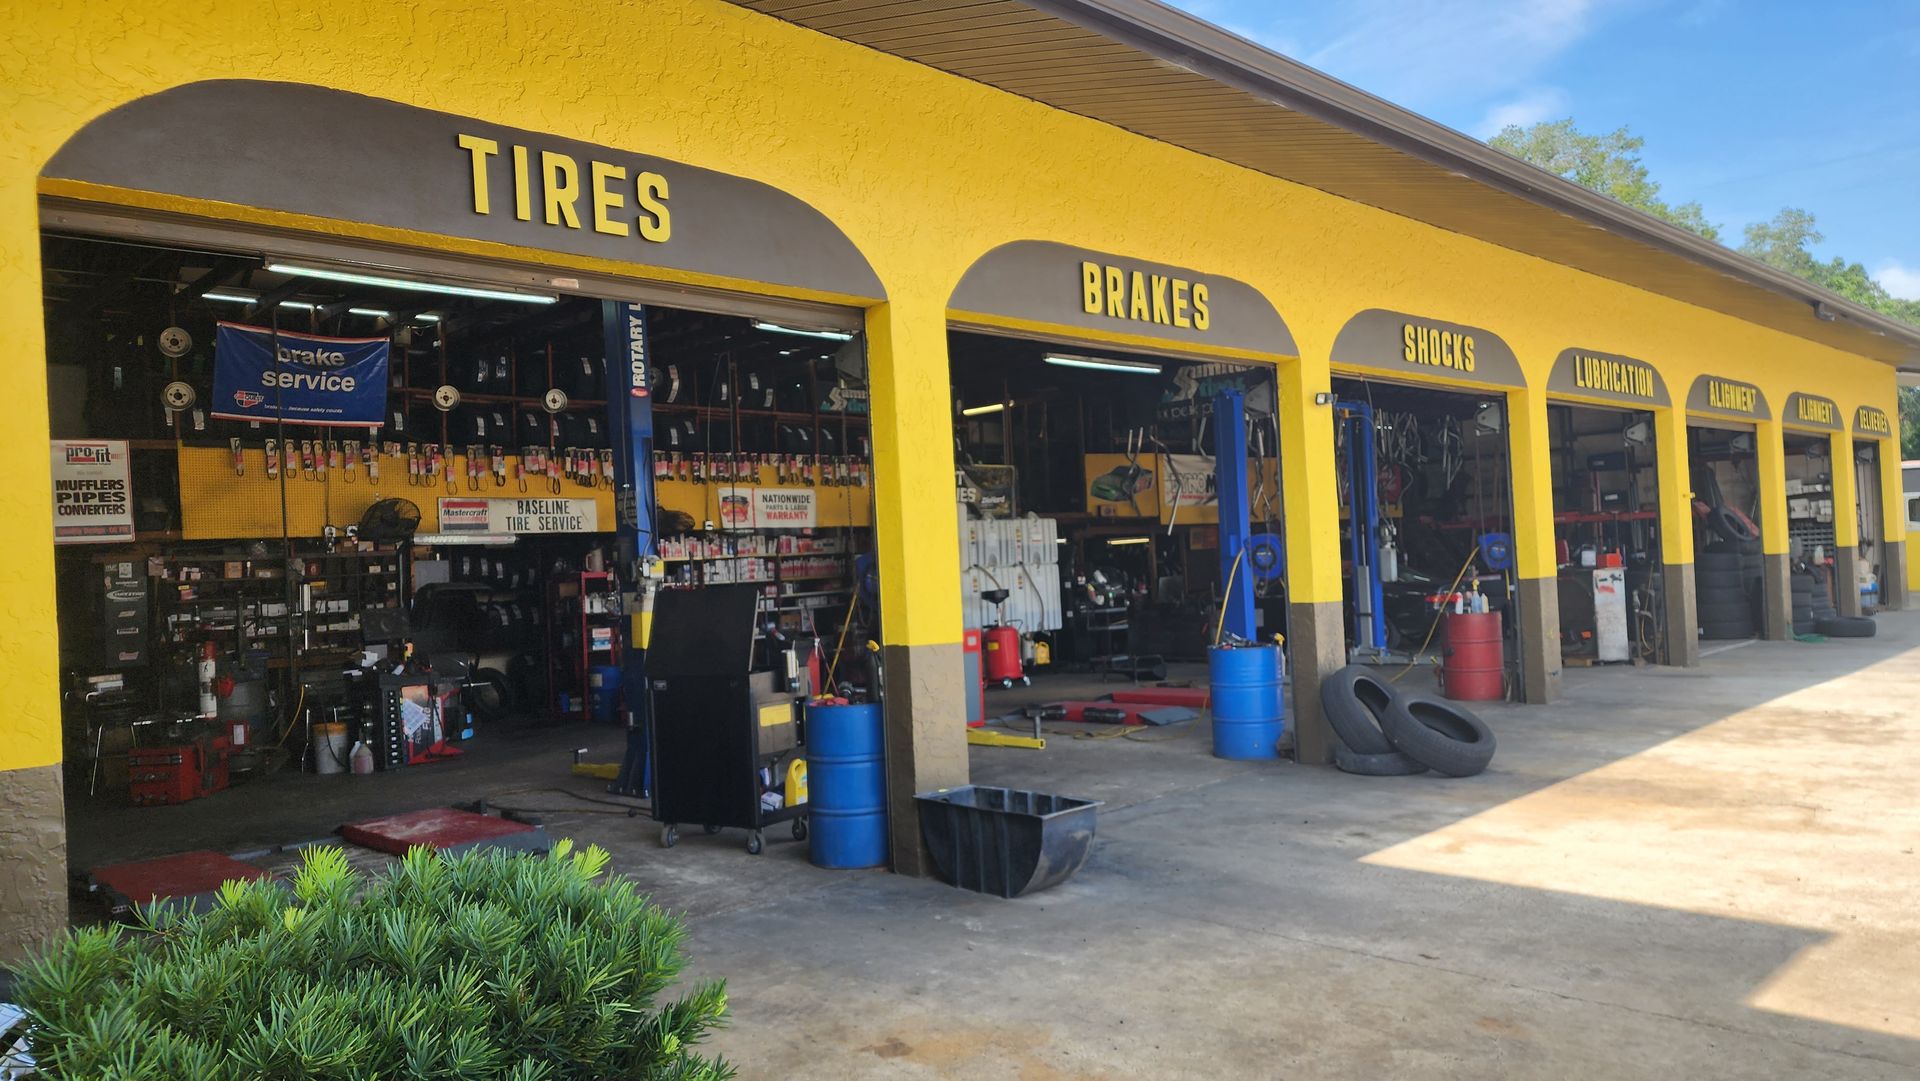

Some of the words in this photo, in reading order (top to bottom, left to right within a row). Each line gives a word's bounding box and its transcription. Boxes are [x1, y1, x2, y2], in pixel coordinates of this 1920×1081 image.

[458, 133, 671, 243] TIRES
[1082, 261, 1210, 330] BRAKES
[277, 343, 345, 367] brake
[629, 315, 646, 387] ROTARY
[1404, 323, 1475, 372] SHOCKS
[261, 370, 356, 392] service
[1575, 355, 1654, 397] LUBRICATION
[1709, 380, 1756, 413] ALIGNMENT
[1798, 397, 1833, 424] ALIGNMENT
[55, 480, 124, 491] MUFFLERS
[56, 492, 126, 503] PIPES
[517, 500, 570, 515] BASELINE
[762, 494, 811, 504] NATIONWIDE
[58, 504, 126, 516] CONVERTERS
[442, 508, 488, 517] Mastercraft
[766, 511, 808, 521] WARRANTY
[505, 516, 530, 531] TIRE
[538, 516, 583, 531] SERVICE
